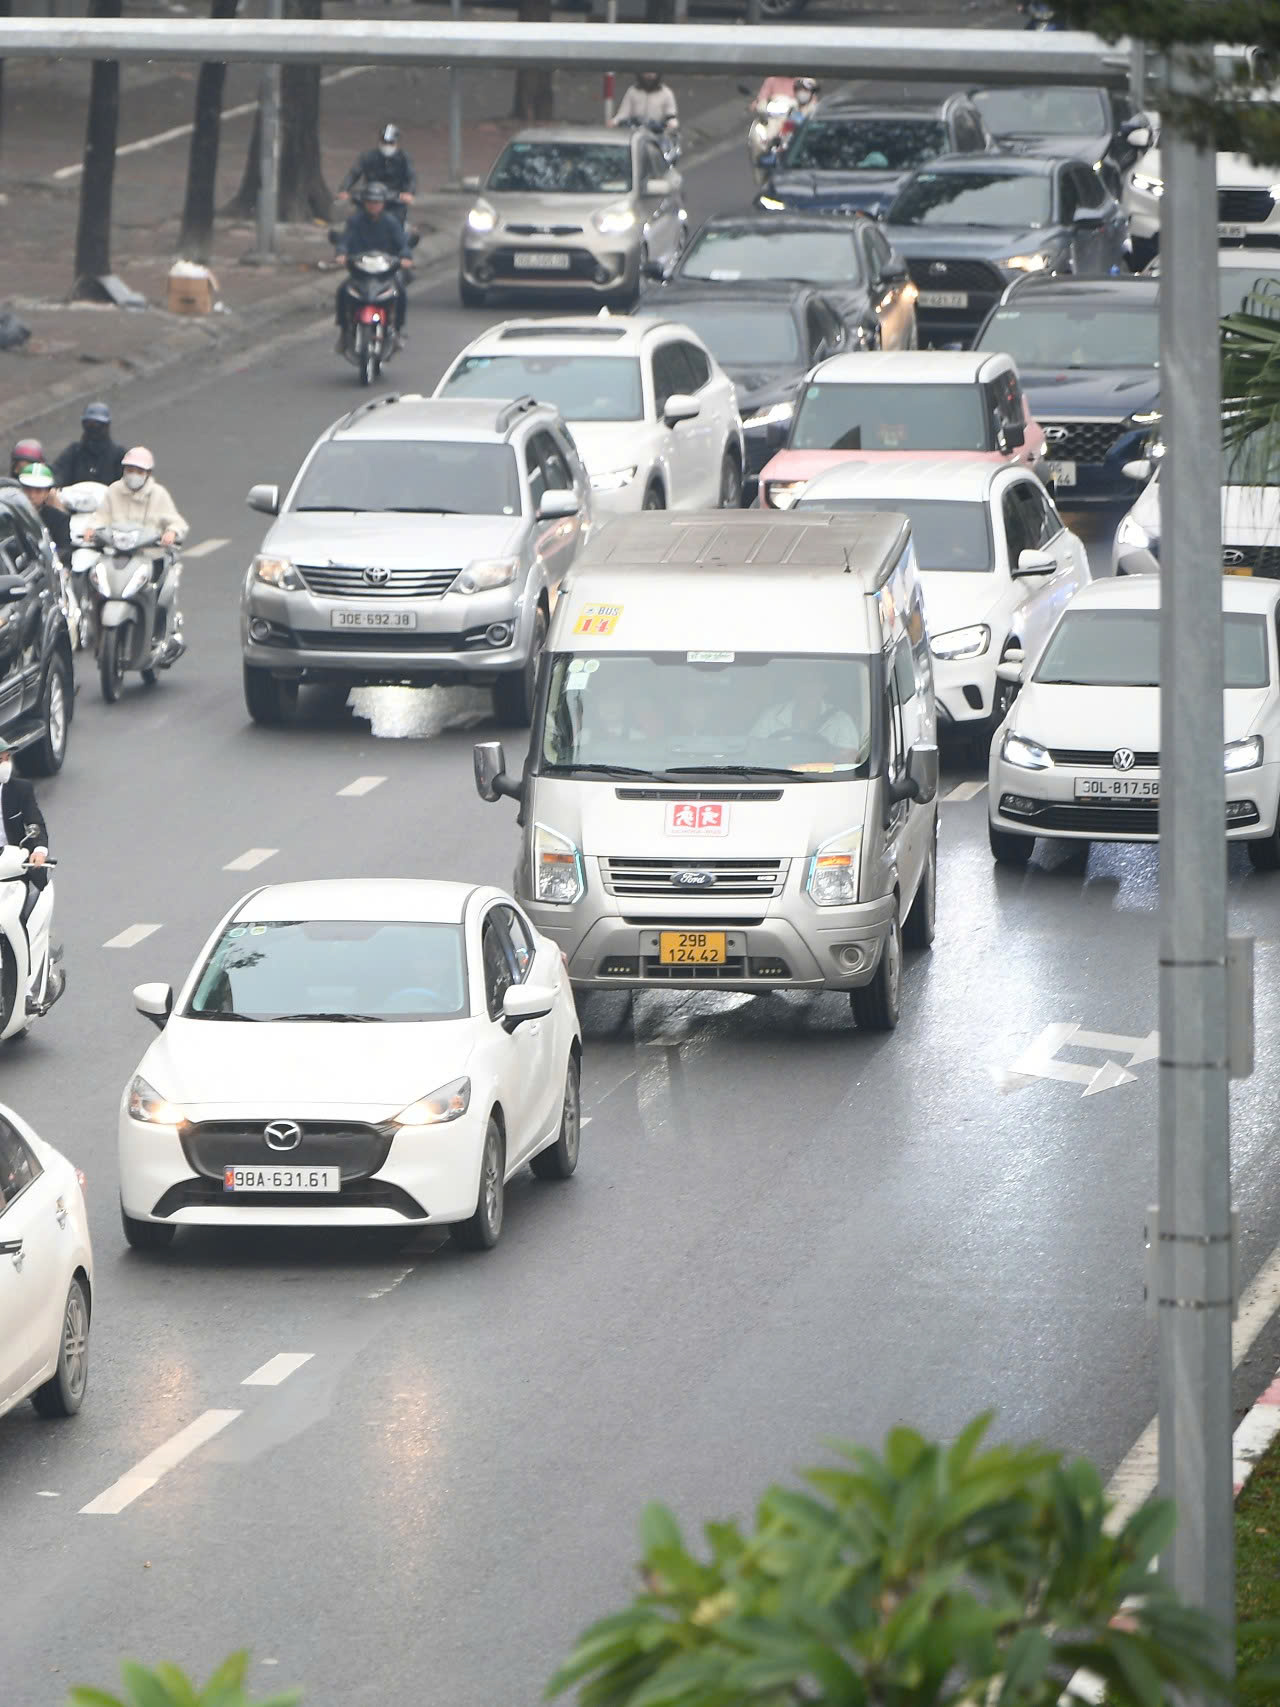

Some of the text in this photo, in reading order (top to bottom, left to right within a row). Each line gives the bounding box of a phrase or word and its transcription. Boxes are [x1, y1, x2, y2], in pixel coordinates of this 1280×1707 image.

[598, 606, 620, 616] BUS
[1082, 780, 1160, 796] 30L-817.58
[679, 872, 706, 885] Ford
[678, 933, 708, 948] 29B
[669, 949, 719, 962] 124.42
[235, 1171, 329, 1187] 98A-631.61
